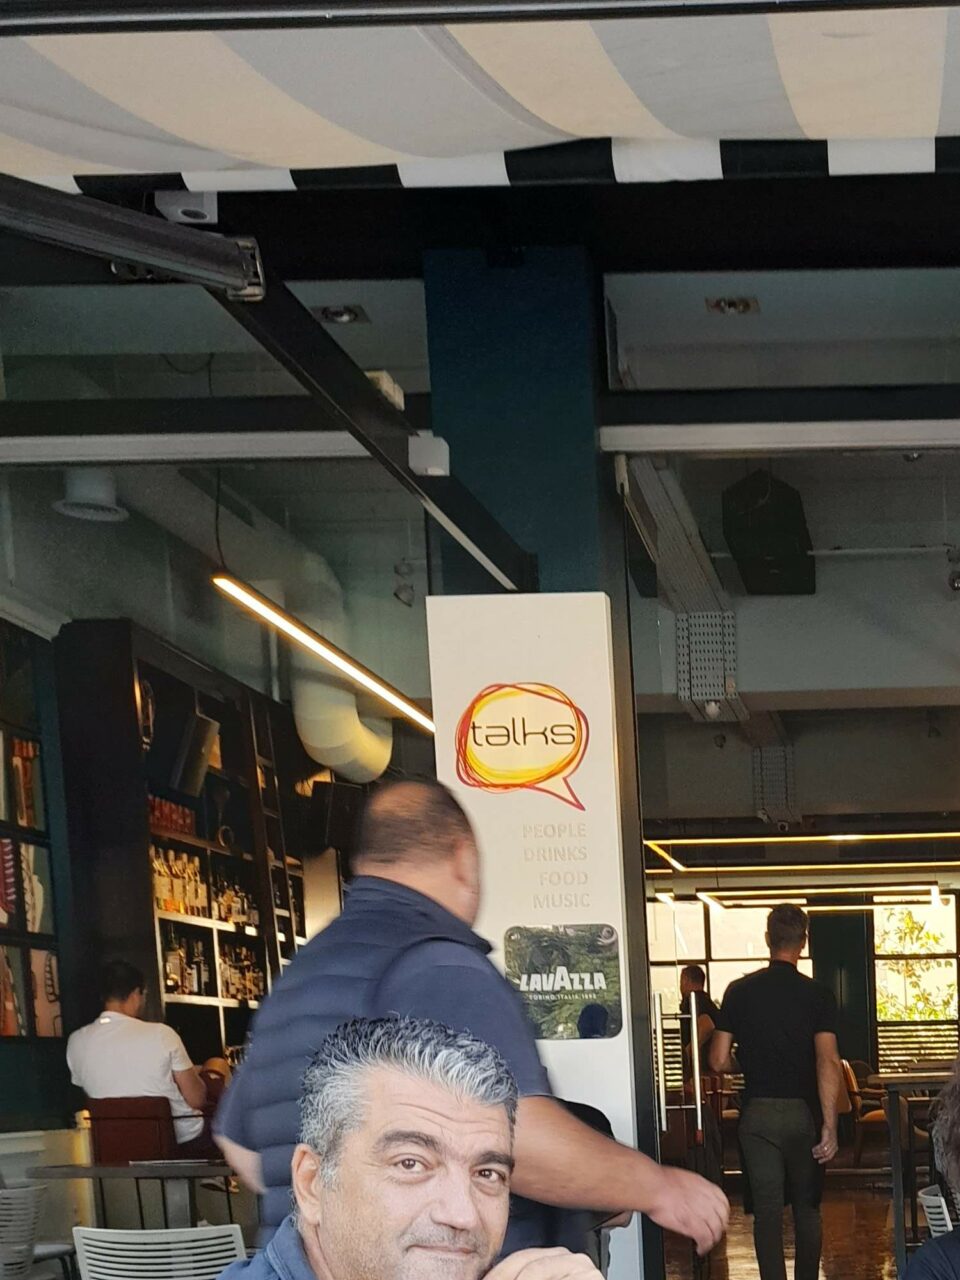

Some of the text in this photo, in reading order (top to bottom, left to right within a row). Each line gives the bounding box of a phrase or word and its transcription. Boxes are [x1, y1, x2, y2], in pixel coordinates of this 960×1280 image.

[471, 716, 576, 747] talks
[522, 822, 587, 839] PEOPLE
[523, 845, 588, 862] DRINKS
[539, 871, 589, 886] FOOD
[532, 892, 591, 909] MUSIC
[519, 965, 607, 992] LAVAZZA
